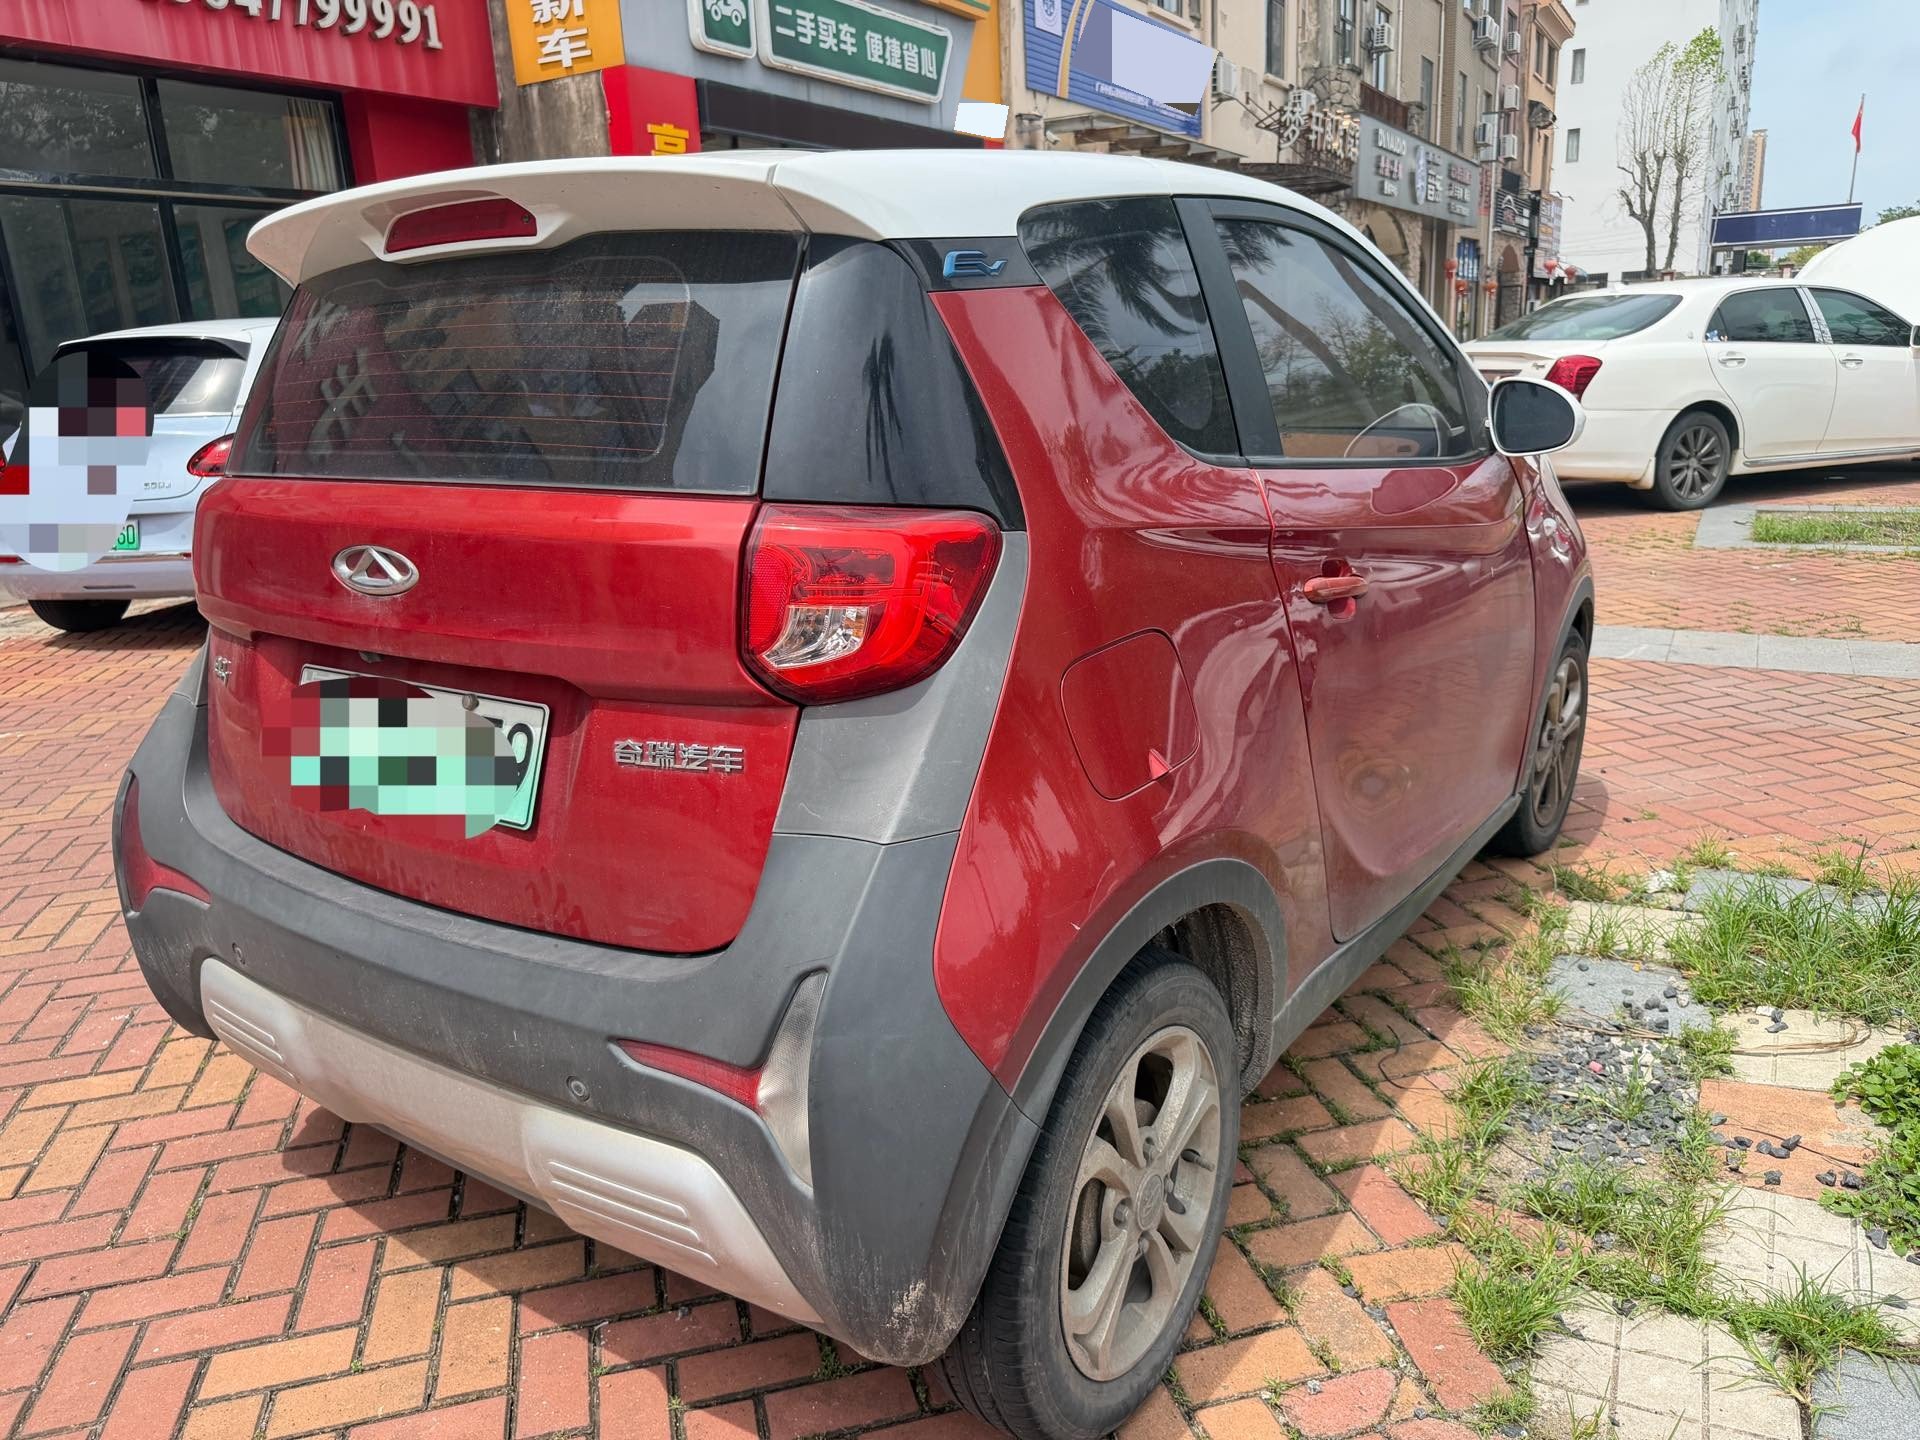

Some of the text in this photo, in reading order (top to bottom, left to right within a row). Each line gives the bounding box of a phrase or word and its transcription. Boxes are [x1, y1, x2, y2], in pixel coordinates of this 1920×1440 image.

[775, 5, 938, 80] 二手买车 便捷省心
[614, 738, 745, 773] 奇瑞汽车
